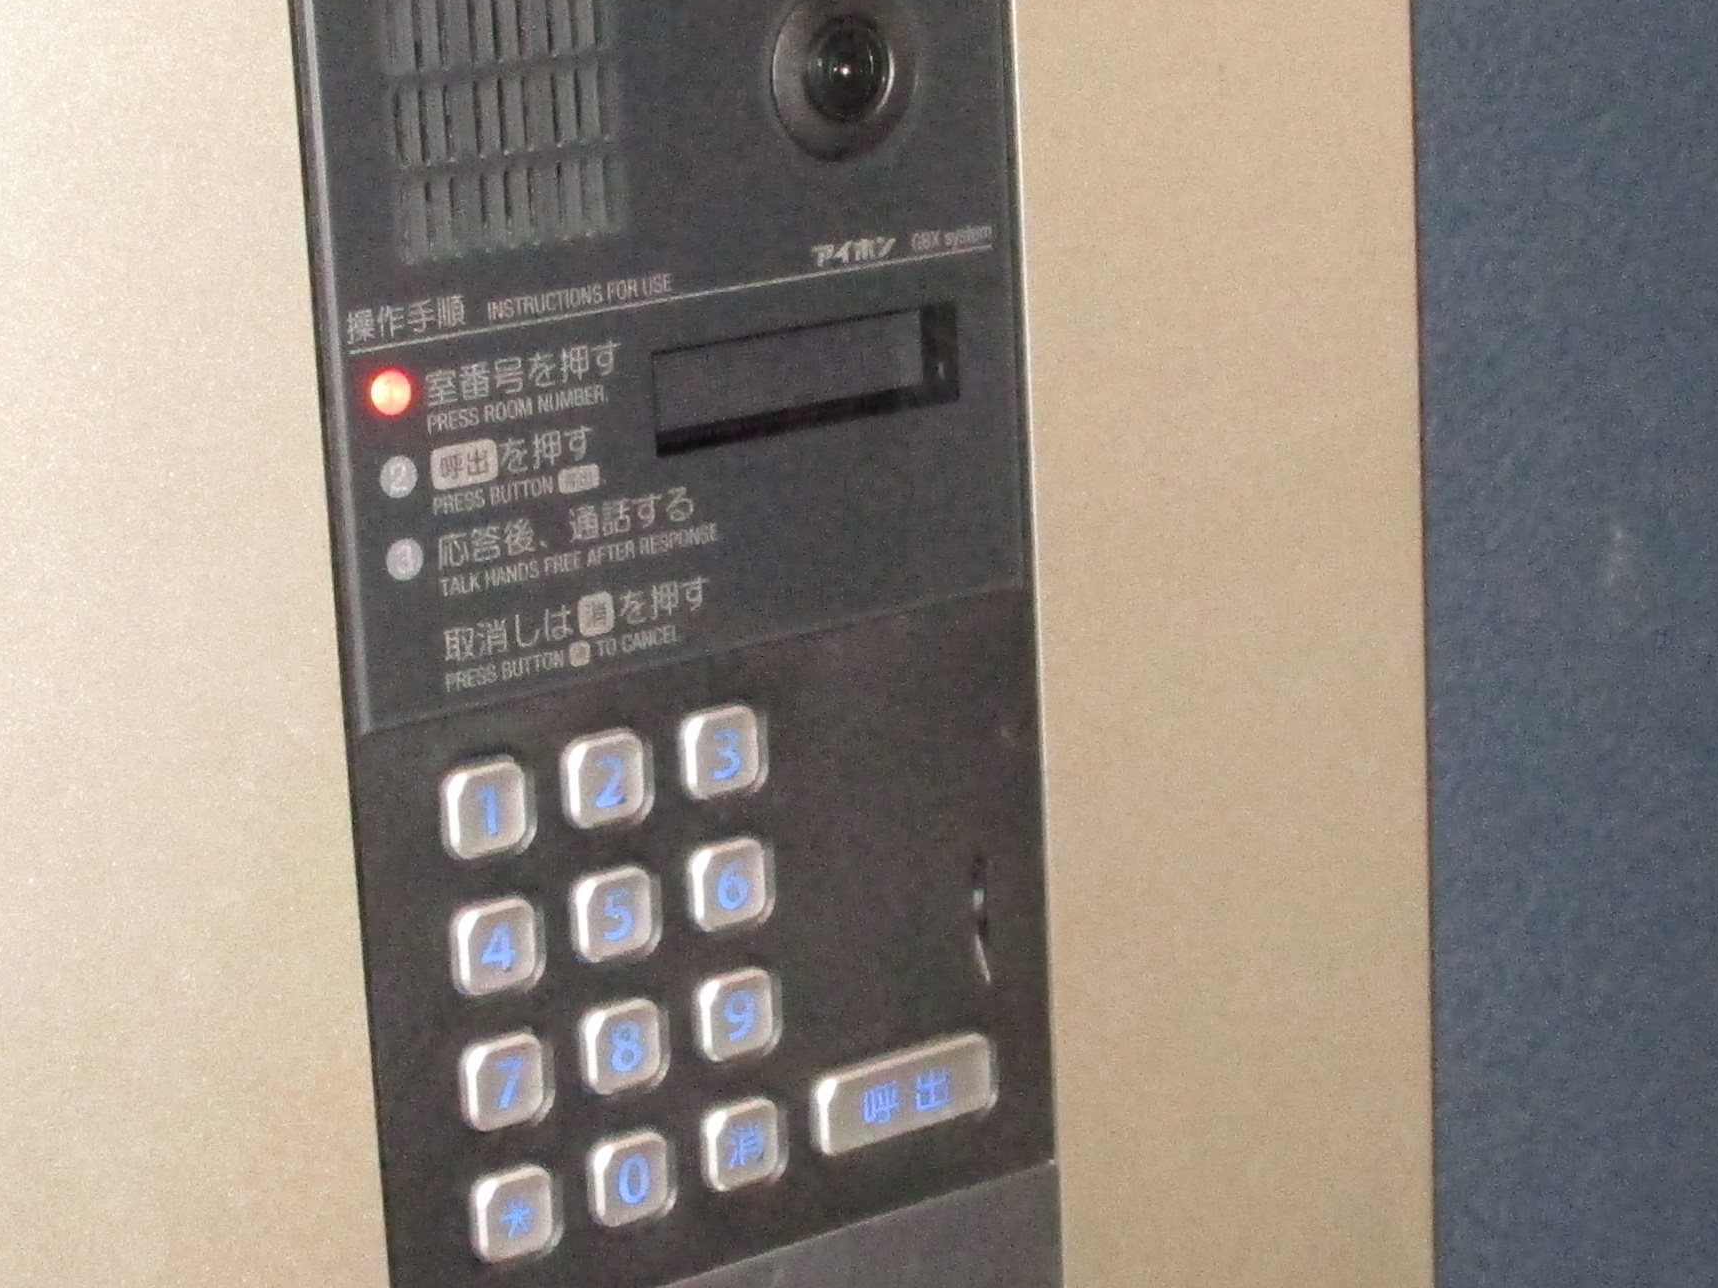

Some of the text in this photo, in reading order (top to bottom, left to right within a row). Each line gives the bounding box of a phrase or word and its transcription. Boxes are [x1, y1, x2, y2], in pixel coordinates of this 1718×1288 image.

[346, 293, 467, 345] 操作手順
[487, 272, 673, 321] INSTRUCTIONS FOR USE
[425, 339, 622, 408] 室番号を押す
[426, 407, 480, 435] PRESS
[484, 396, 533, 424] ROOM
[432, 488, 486, 516] PRESS
[489, 476, 554, 507] BUTTON
[439, 570, 482, 598] TALK
[484, 559, 541, 591] HANDS
[544, 549, 583, 575] FREE
[586, 539, 636, 569] AFTER
[445, 663, 499, 693] PRESS
[501, 648, 566, 682] BUTTON
[597, 635, 617, 658] TO
[710, 727, 742, 781] 3
[596, 755, 627, 809] 2
[478, 784, 500, 836] 1
[716, 862, 749, 911] 6
[601, 887, 634, 943] 5
[481, 922, 517, 974] 4
[723, 989, 757, 1042] 9
[609, 1020, 643, 1073] 8
[494, 1054, 524, 1110] 7
[725, 1121, 764, 1168] 消
[617, 1154, 650, 1206] 0
